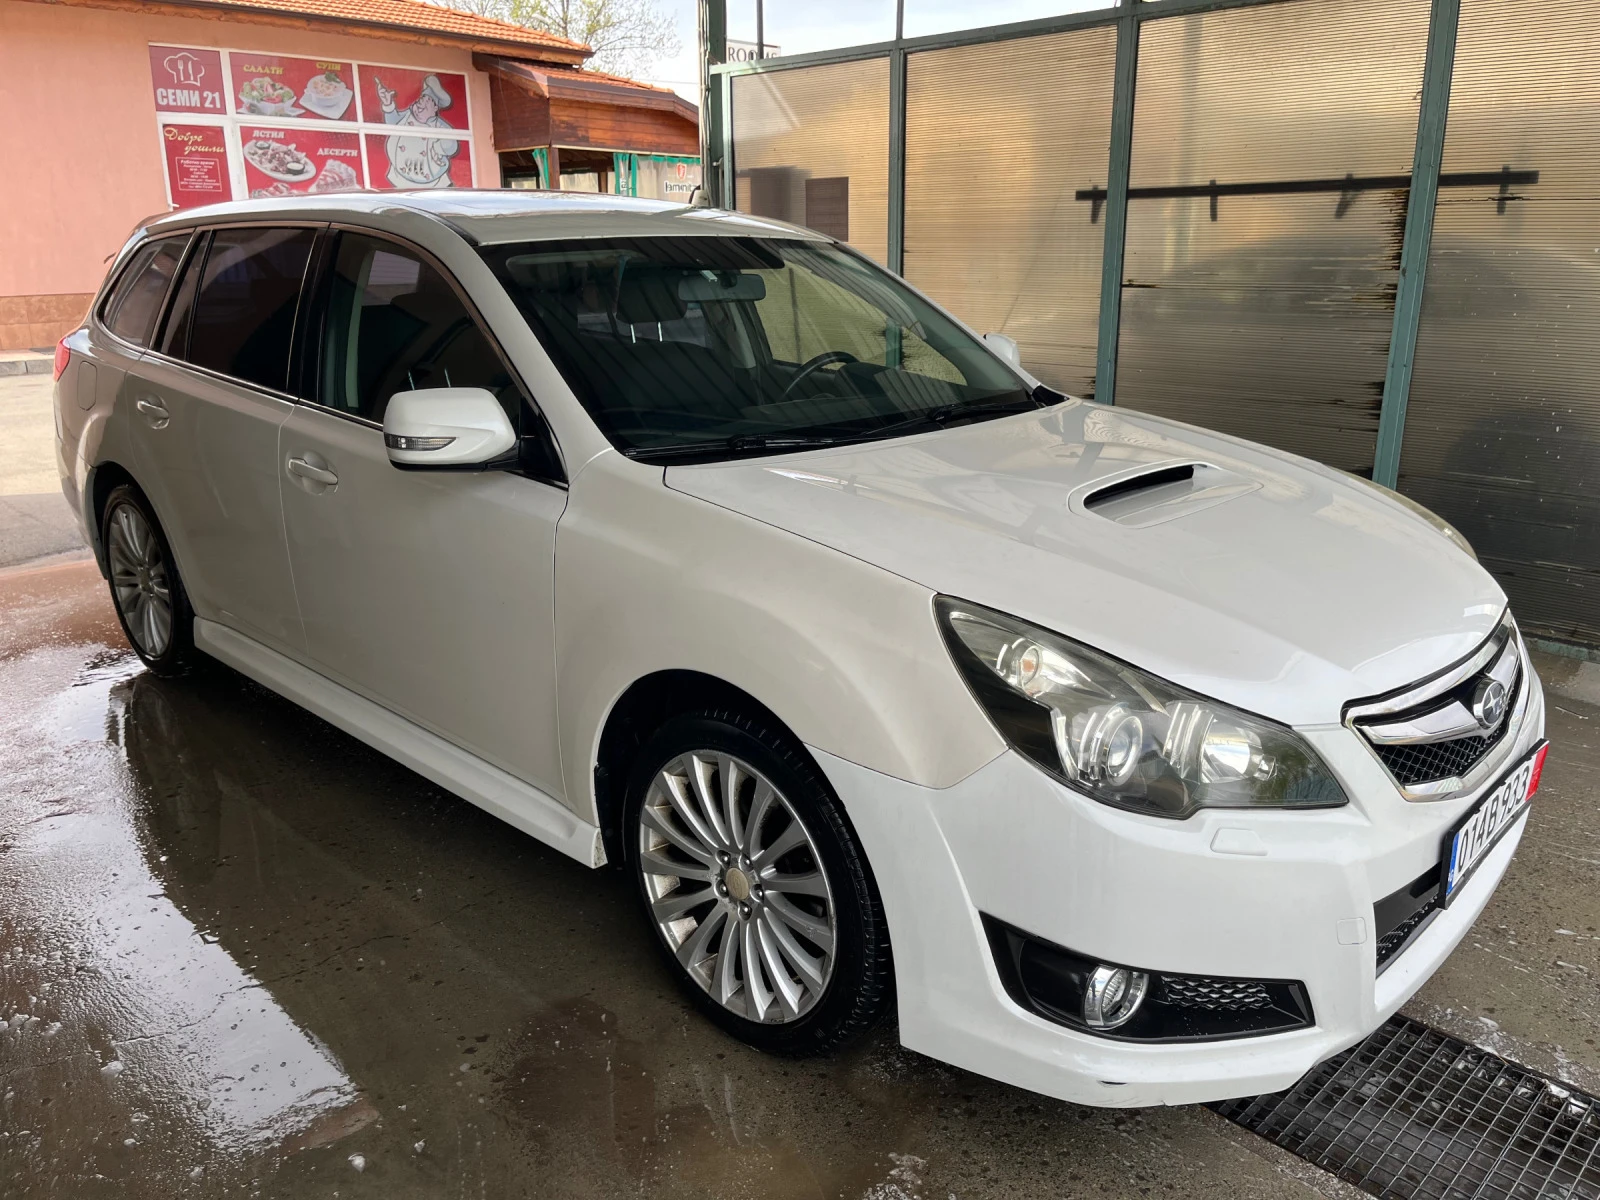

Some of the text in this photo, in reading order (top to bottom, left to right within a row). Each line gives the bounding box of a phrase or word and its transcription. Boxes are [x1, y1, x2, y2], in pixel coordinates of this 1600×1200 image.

[728, 47, 777, 62] ROO
[243, 64, 284, 75] САЛАТИ
[316, 62, 341, 71] СУПИ
[156, 88, 221, 109] СЕМИ 21
[164, 126, 203, 145] Добре
[252, 130, 285, 139] ЯСТИЯ
[184, 144, 225, 155] дошли
[316, 147, 358, 157] ДЕСЕРТИ
